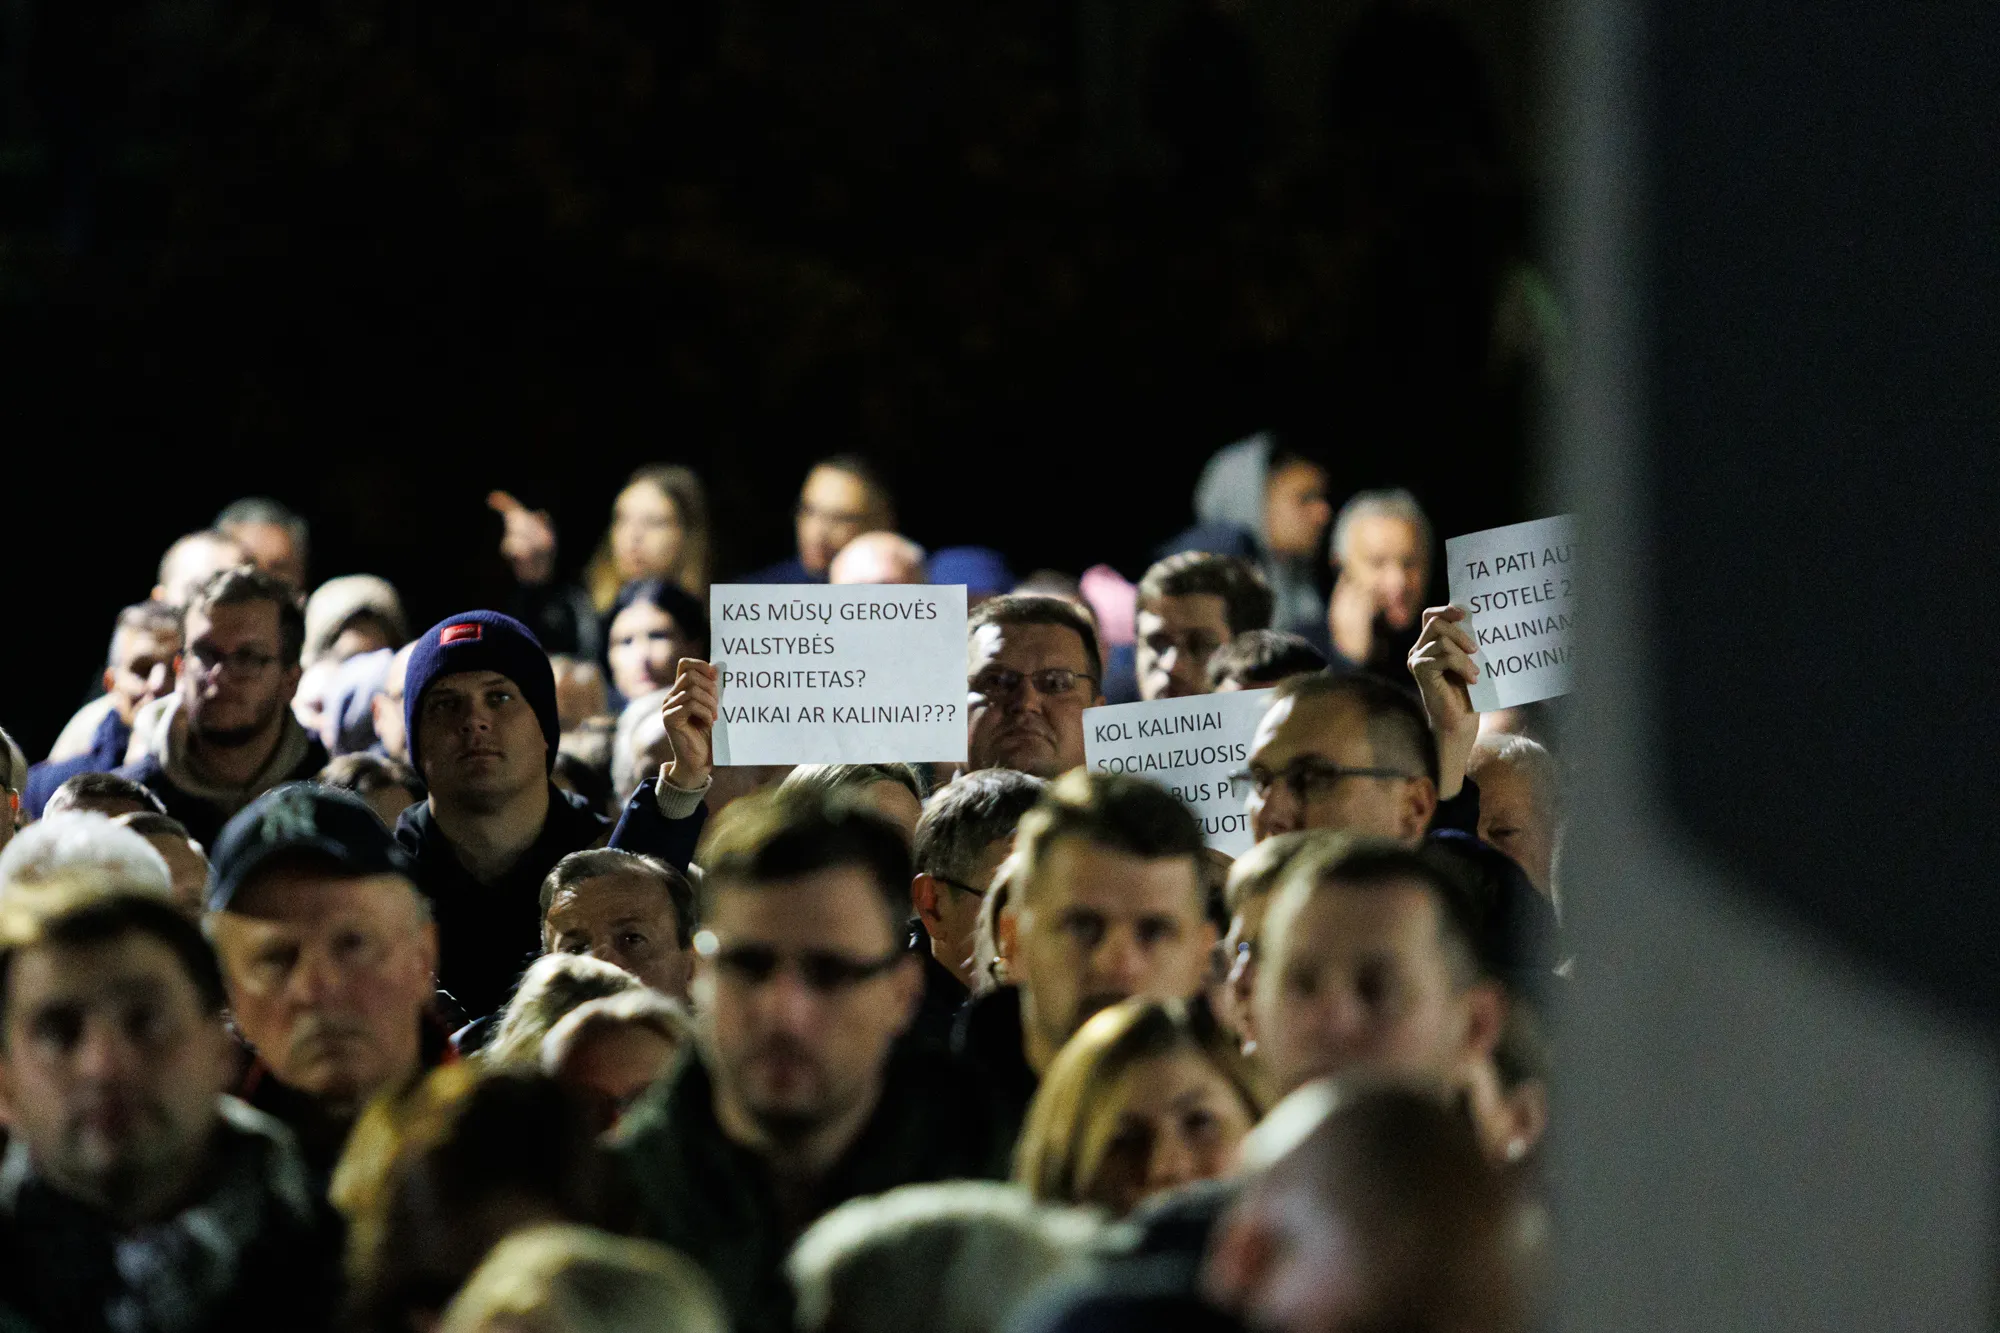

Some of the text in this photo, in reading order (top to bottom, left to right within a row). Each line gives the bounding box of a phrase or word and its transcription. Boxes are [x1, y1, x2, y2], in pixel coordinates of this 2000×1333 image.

[1466, 561, 1490, 580] TA
[1496, 552, 1535, 576] PATI
[1470, 579, 1555, 614] STOTELĖ
[722, 599, 938, 625] KAS MŪSŲ GEROVĖS
[721, 633, 835, 655] VALSTYBĖS
[722, 669, 866, 689] PRIORITETAS?
[722, 704, 956, 723] VAIKAI AR KALINIAI???
[1095, 711, 1222, 743] KOL KALINIAI
[1098, 743, 1247, 775] SOCIALIZUOSIS
